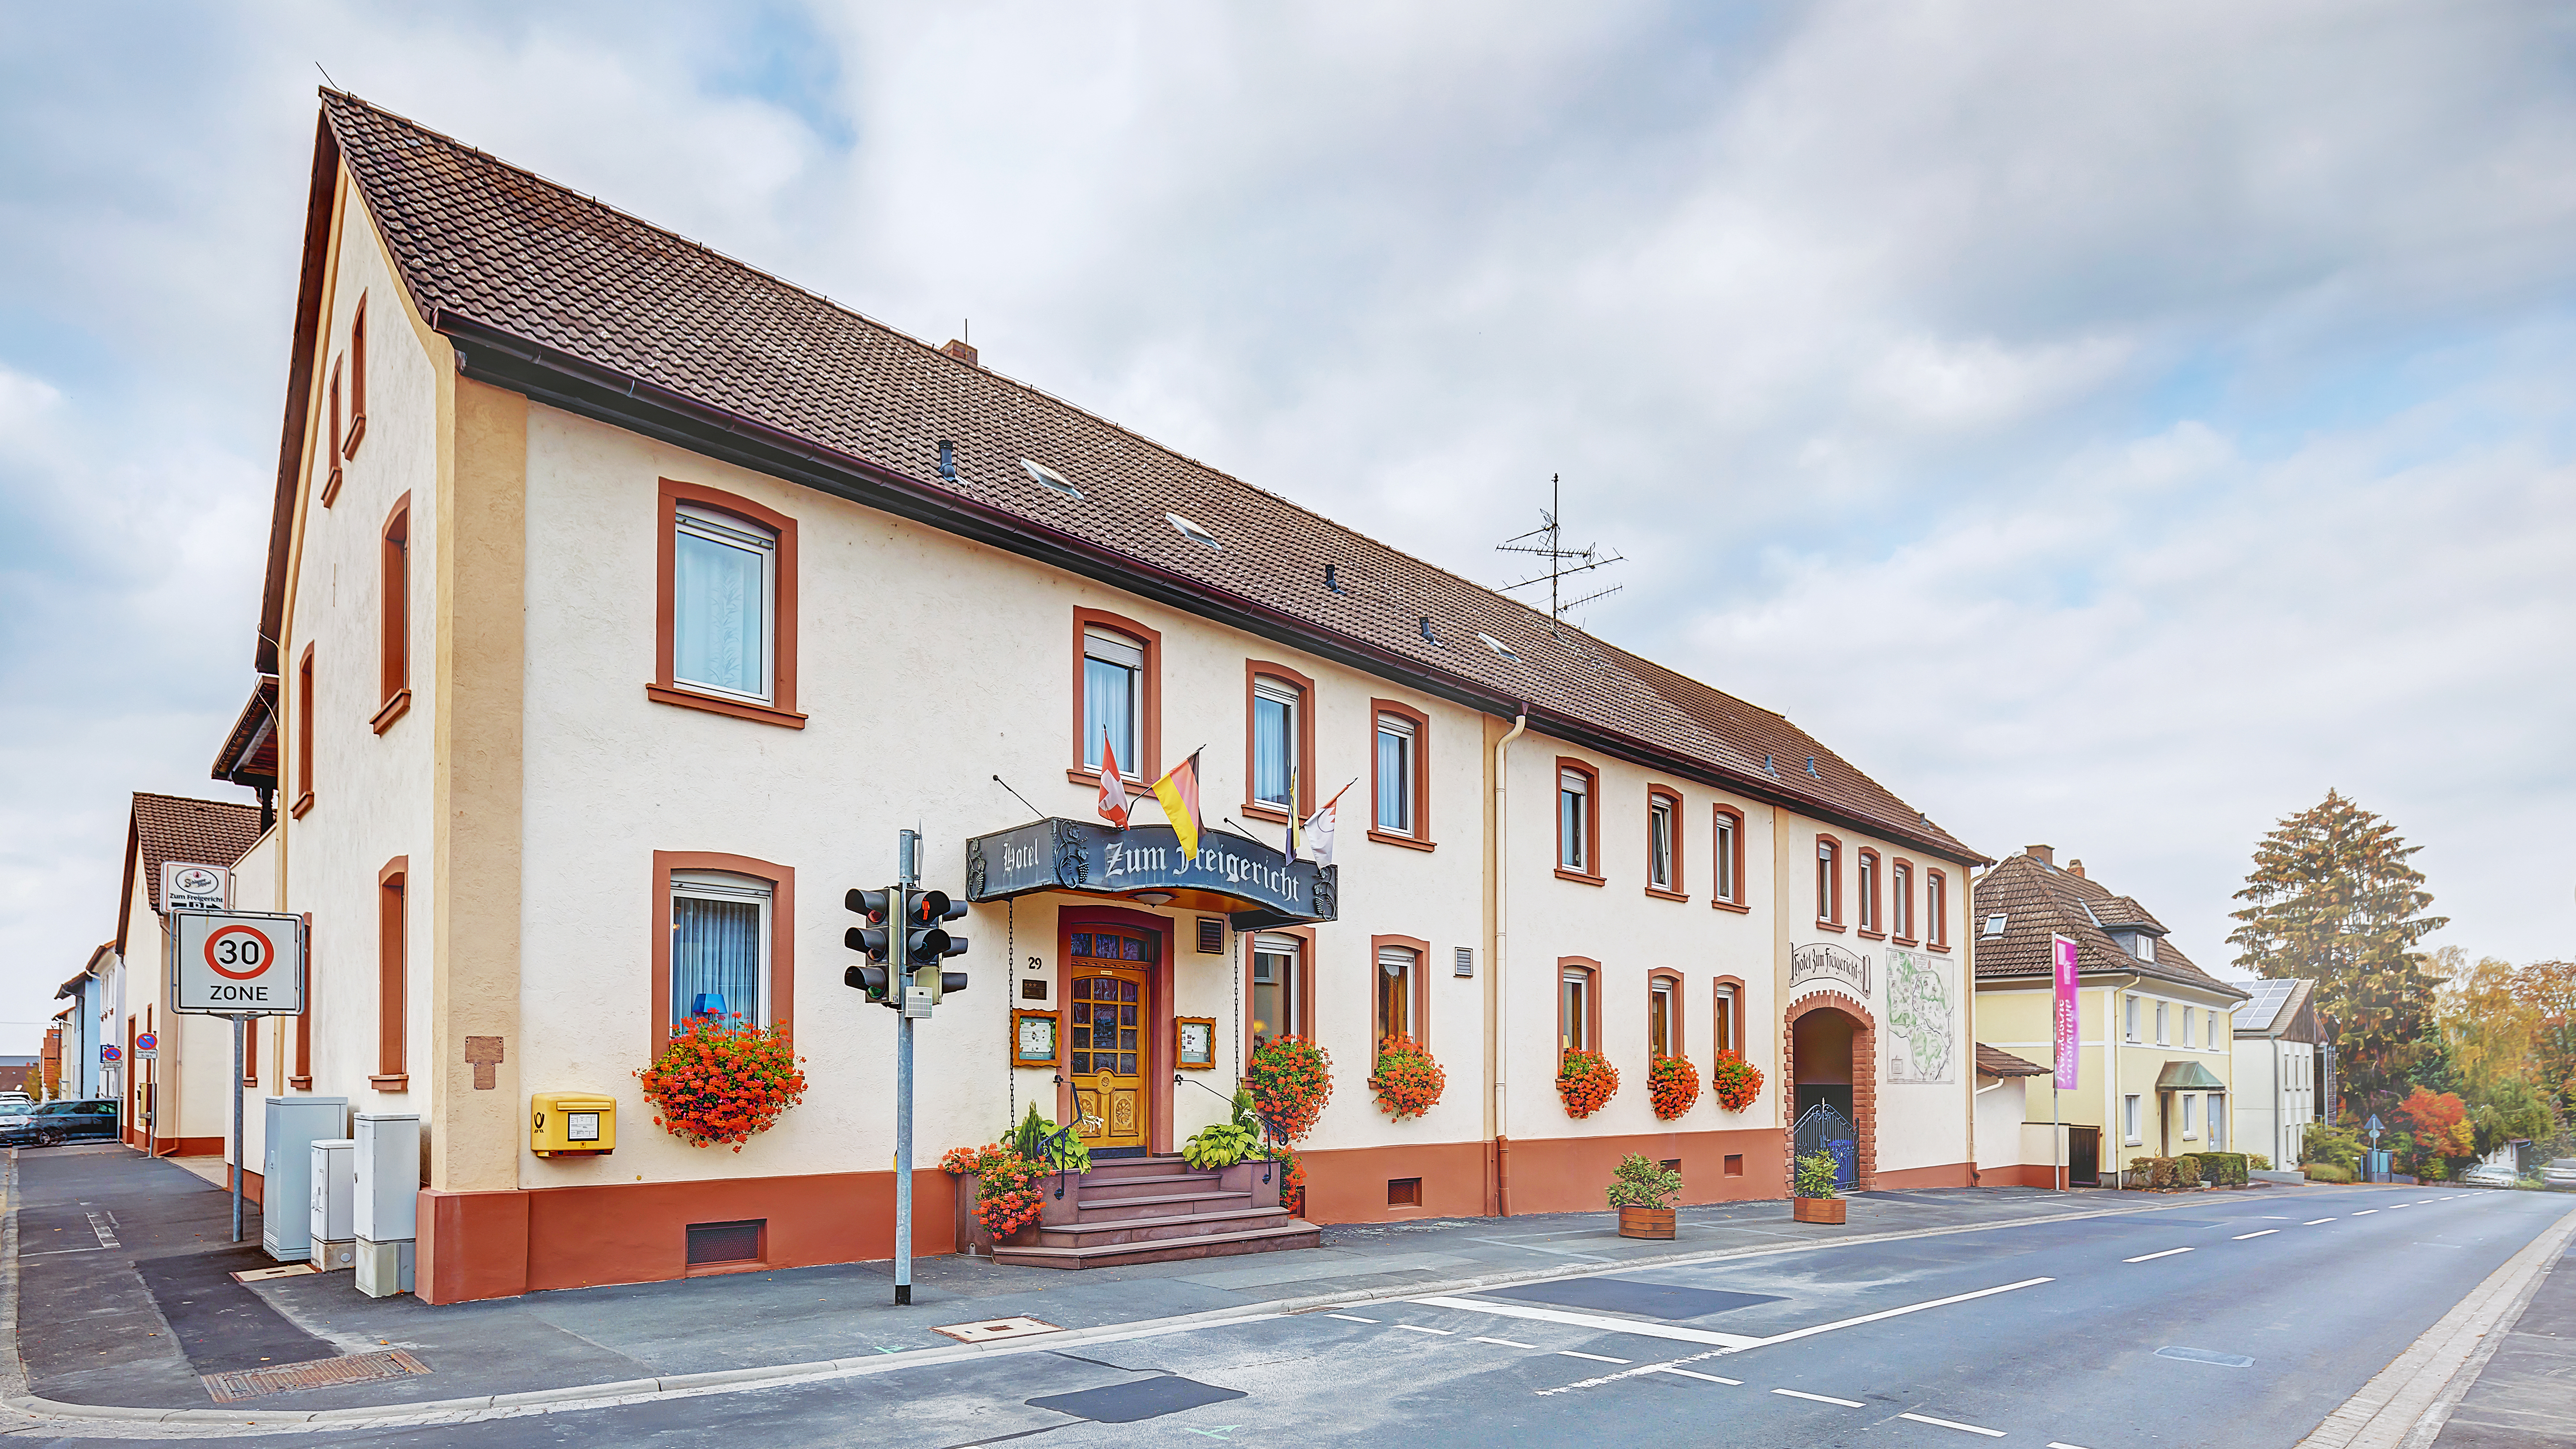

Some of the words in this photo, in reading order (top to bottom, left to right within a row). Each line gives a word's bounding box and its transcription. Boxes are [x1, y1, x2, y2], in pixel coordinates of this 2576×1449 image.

[1003, 837, 1039, 876] Hotel
[1105, 840, 1169, 878] Zum
[187, 894, 223, 902] Freigericht
[219, 940, 259, 965] 30
[1028, 956, 1042, 970] 29
[1794, 951, 1811, 981] Hotel
[1812, 948, 1824, 974] Zum
[1825, 948, 1857, 982] Freigericht
[210, 985, 268, 1001] ZONE
